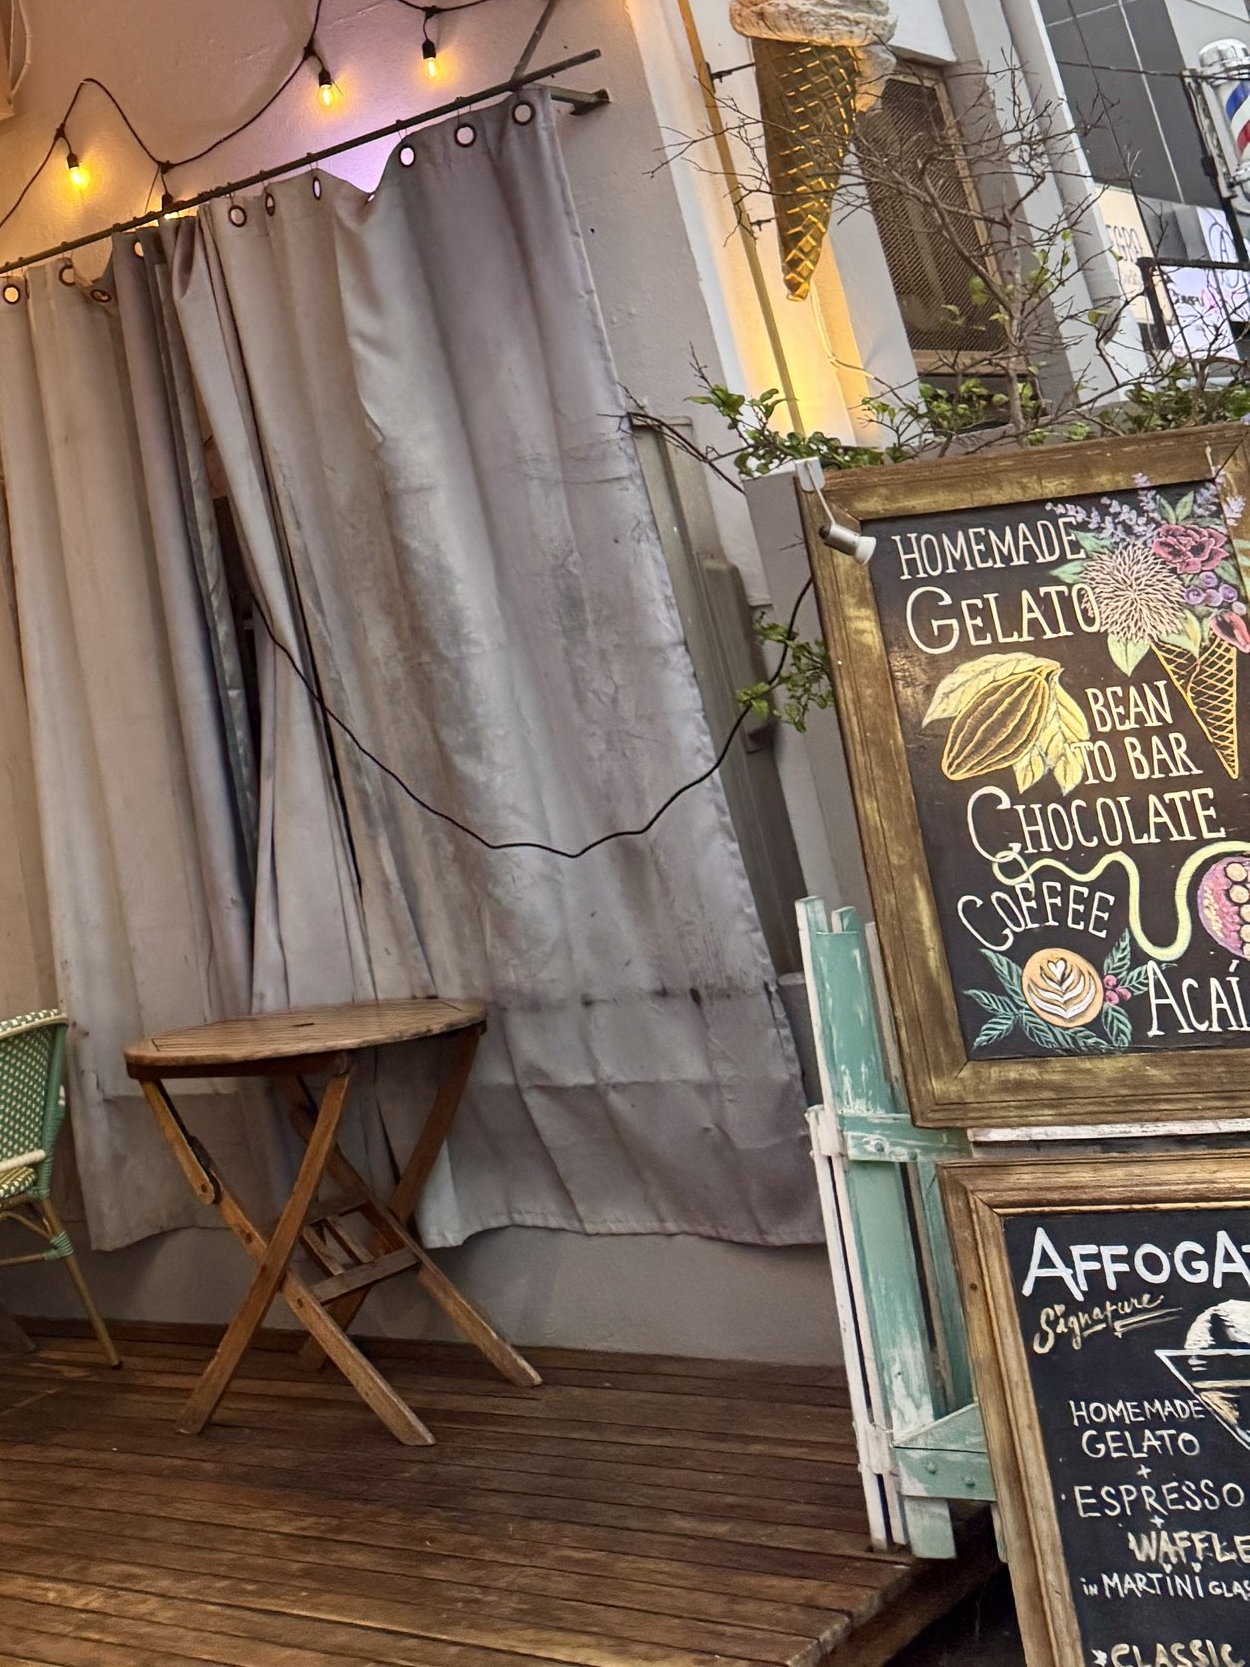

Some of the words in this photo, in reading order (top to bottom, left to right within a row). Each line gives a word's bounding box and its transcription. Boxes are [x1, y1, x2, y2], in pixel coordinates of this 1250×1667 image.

[891, 515, 1087, 581] HOMEMADE
[905, 582, 1101, 655] GELATO
[1085, 679, 1174, 734] BEAN
[1125, 731, 1204, 781] BAR
[966, 785, 1227, 863] CHOCOLATE
[956, 880, 1116, 952] COFFEE
[1021, 1226, 1250, 1302] AFFOGA
[1033, 1292, 1165, 1355] Signature
[1068, 1397, 1206, 1427] HOMEMADE
[1081, 1429, 1201, 1459] GELATO
[1073, 1479, 1245, 1518] ESPRESSO
